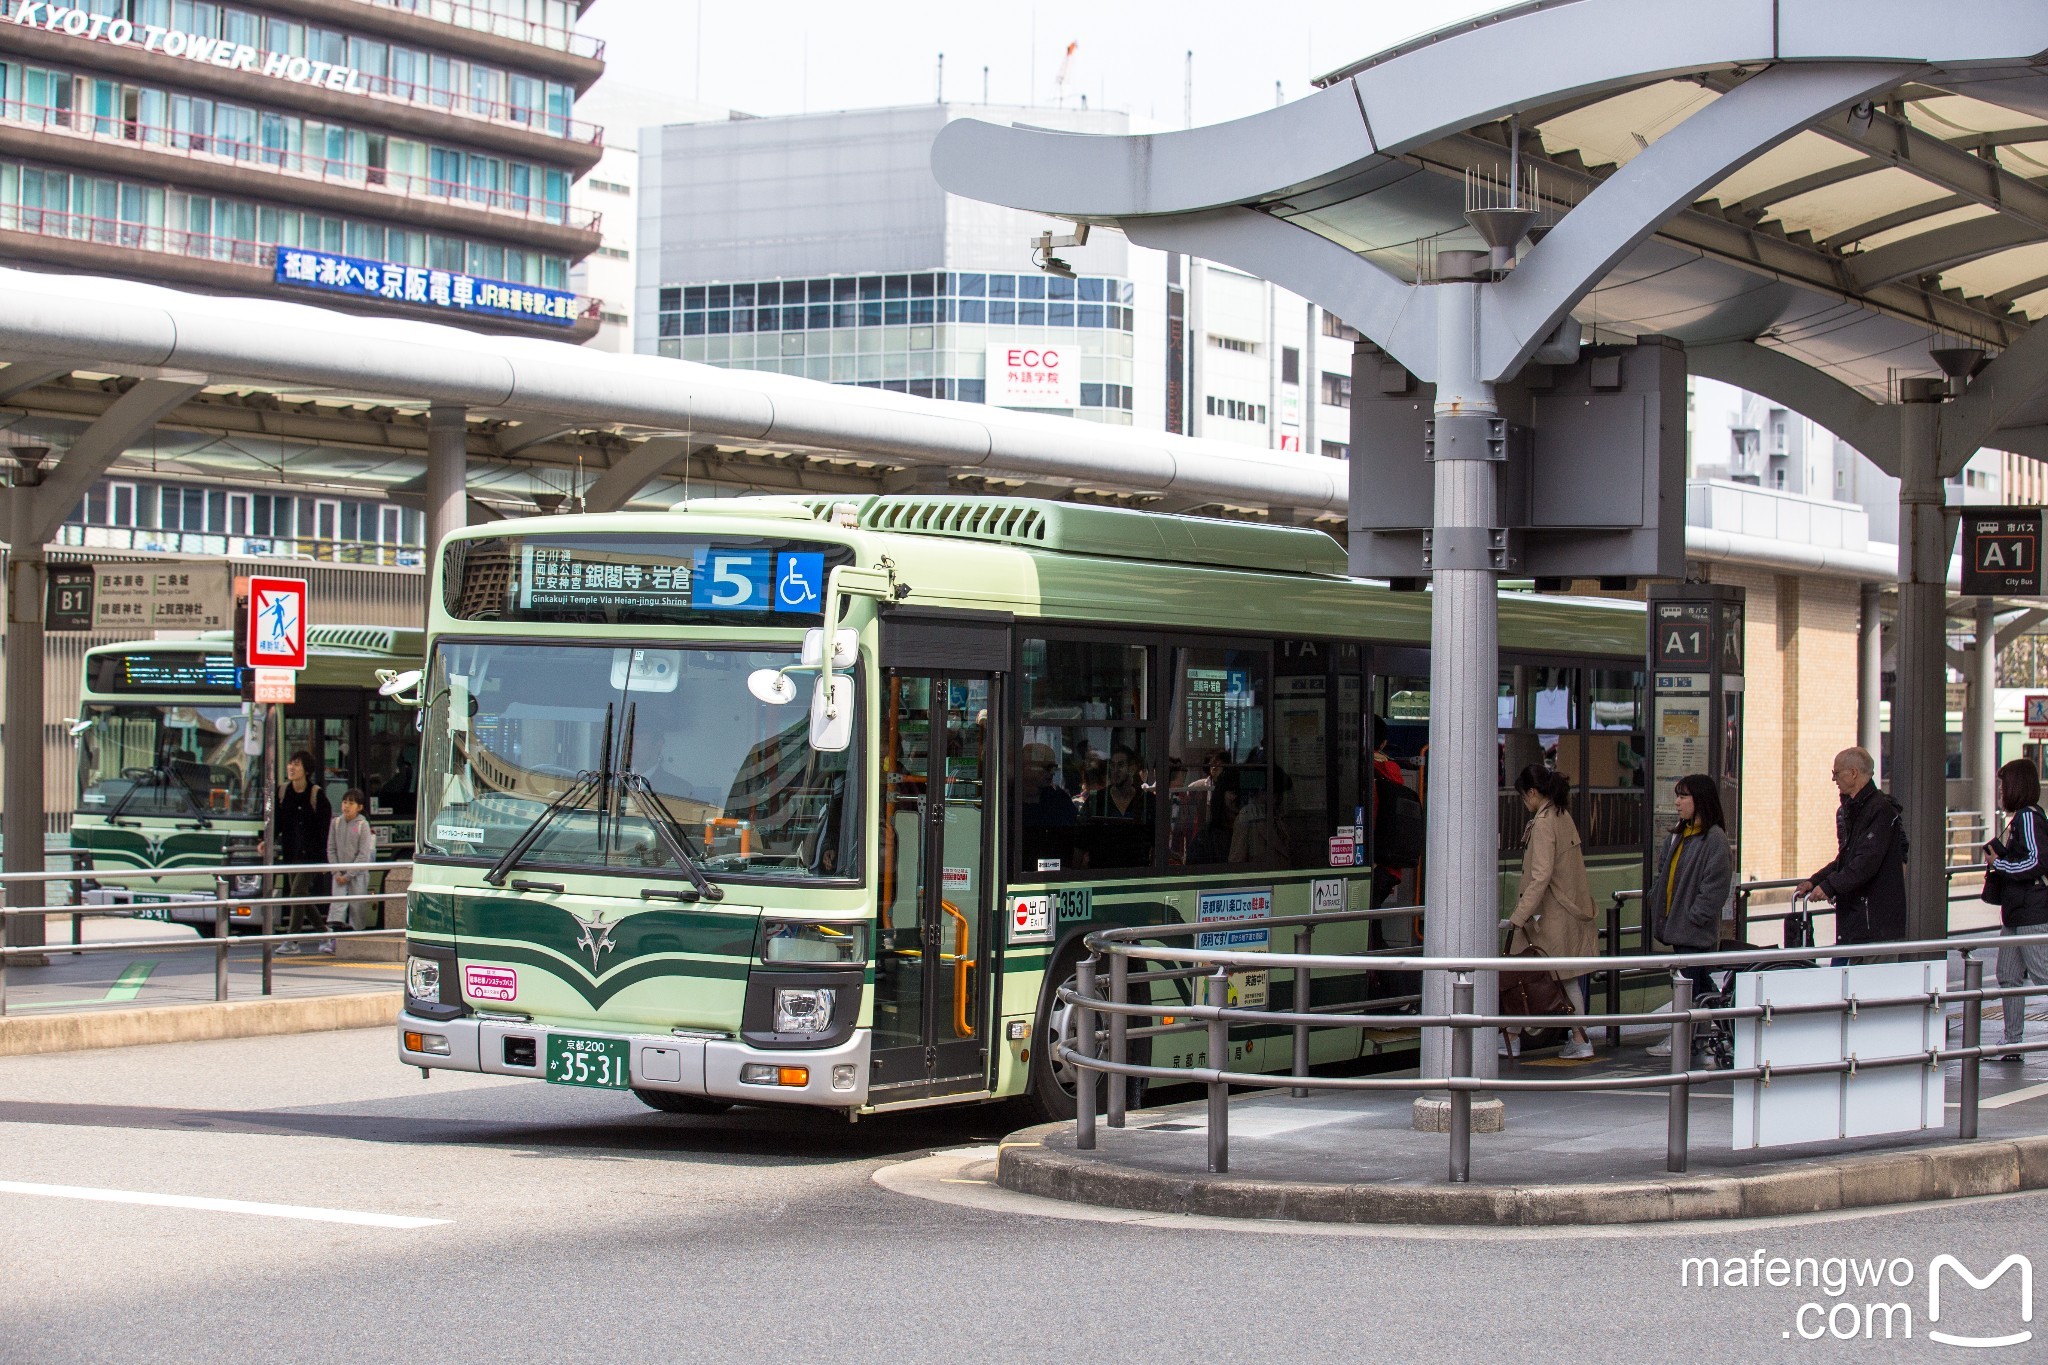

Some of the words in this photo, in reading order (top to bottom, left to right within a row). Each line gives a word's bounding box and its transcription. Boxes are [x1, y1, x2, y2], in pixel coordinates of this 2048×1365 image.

[14, 1, 133, 45] KYOTO
[143, 25, 256, 71] TOWER
[262, 52, 365, 93] HOTEL
[1008, 350, 1058, 368] ECC
[1008, 371, 1059, 383] 外語学院
[2007, 523, 2034, 532] 市バス
[536, 550, 571, 561] 白川通
[535, 563, 582, 576] 岡崎公園
[102, 575, 144, 587] 西本願寺
[157, 574, 189, 586] 二条城
[535, 577, 582, 589] 平安神宮
[585, 565, 692, 589] 銀閣寺・岩倉
[711, 556, 753, 605] 5
[2005, 578, 2019, 586] City
[61, 591, 82, 610] B1
[532, 594, 568, 603] Ginkakuji
[570, 595, 598, 604] Temple
[599, 596, 612, 604] Via
[661, 597, 687, 605] Shrine
[1232, 673, 1242, 694] 5
[1662, 678, 1669, 686] 5
[1325, 884, 1339, 898] 入口
[1029, 900, 1047, 915] 出口
[1061, 891, 1089, 918] 3531
[1030, 918, 1043, 926] EXIT
[550, 1060, 559, 1069] か
[561, 1052, 622, 1086] 35-31
